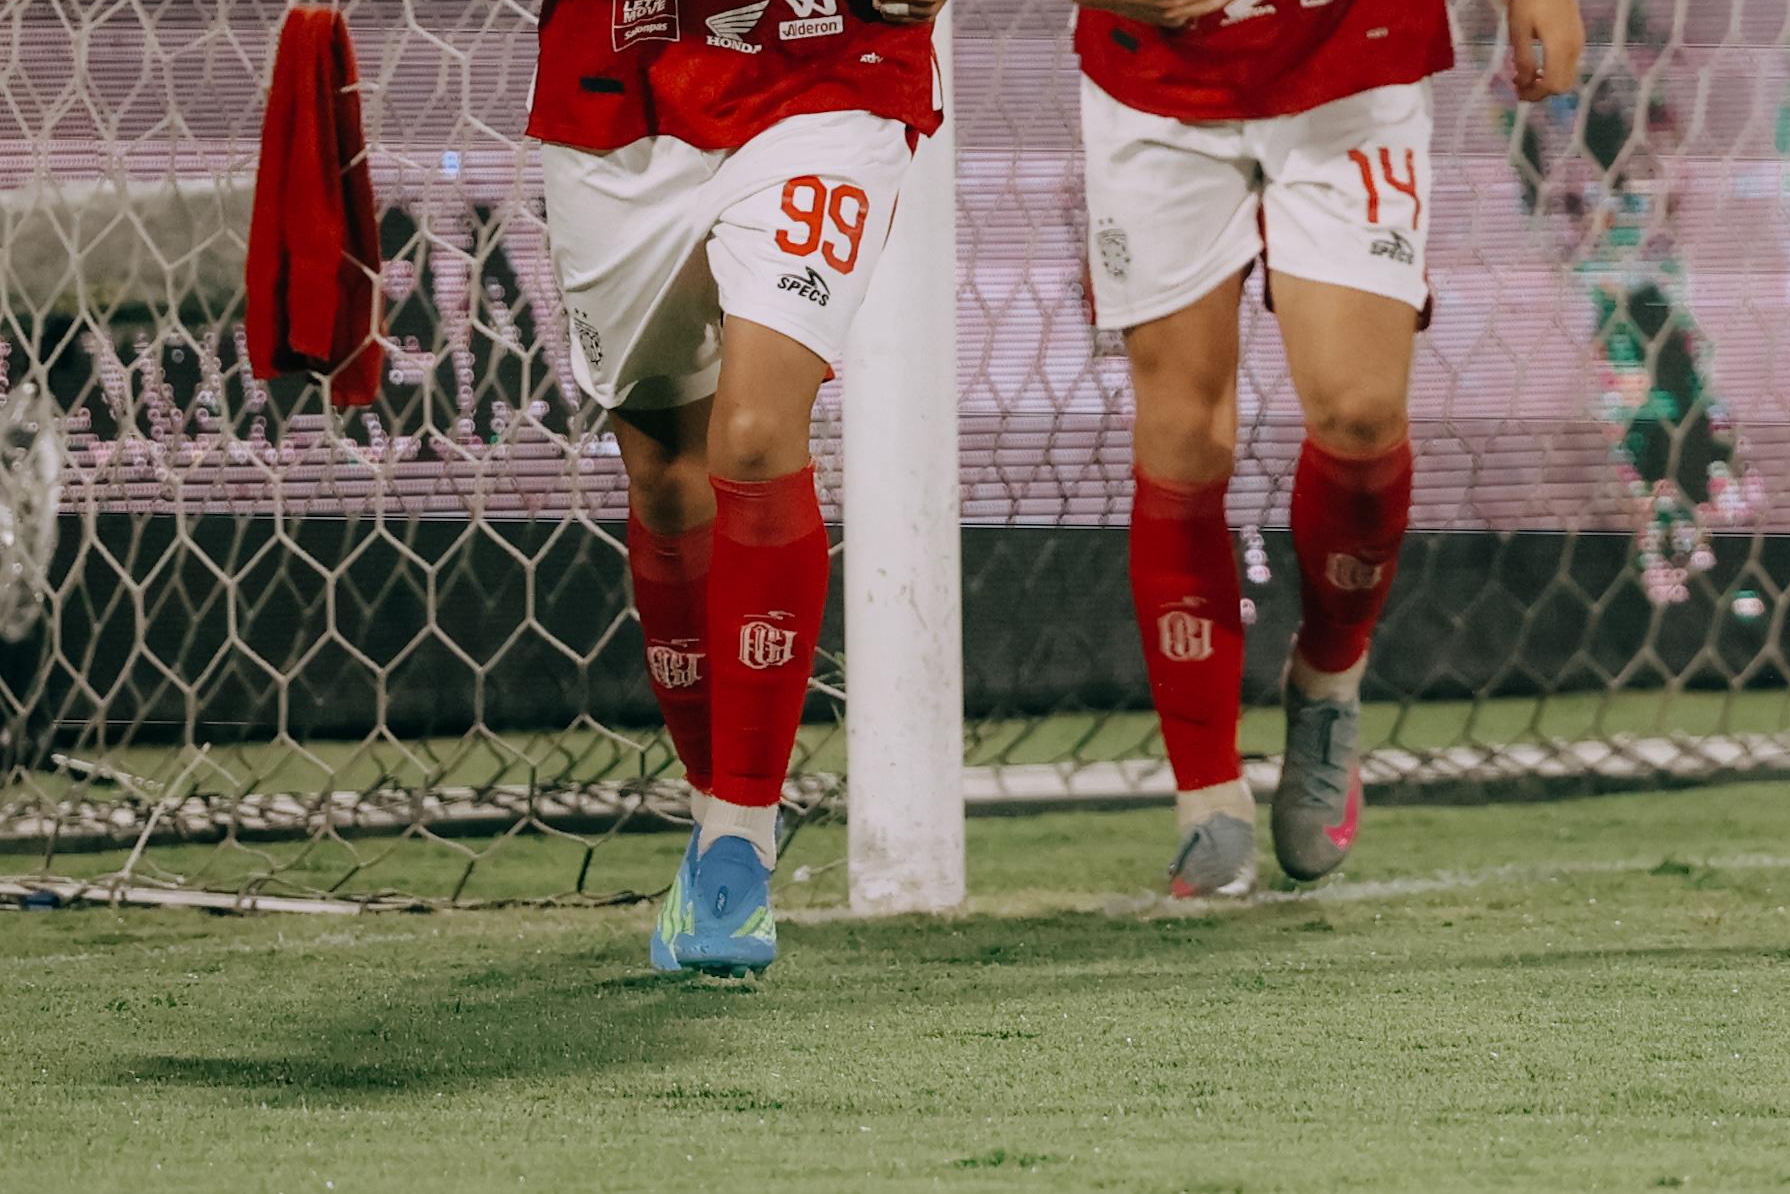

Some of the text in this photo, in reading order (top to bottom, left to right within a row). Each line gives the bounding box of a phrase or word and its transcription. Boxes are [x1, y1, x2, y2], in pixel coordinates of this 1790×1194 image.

[782, 20, 838, 37] Alderon
[1348, 146, 1422, 231] 14
[775, 175, 870, 275] 99
[777, 276, 830, 308] SPECS
